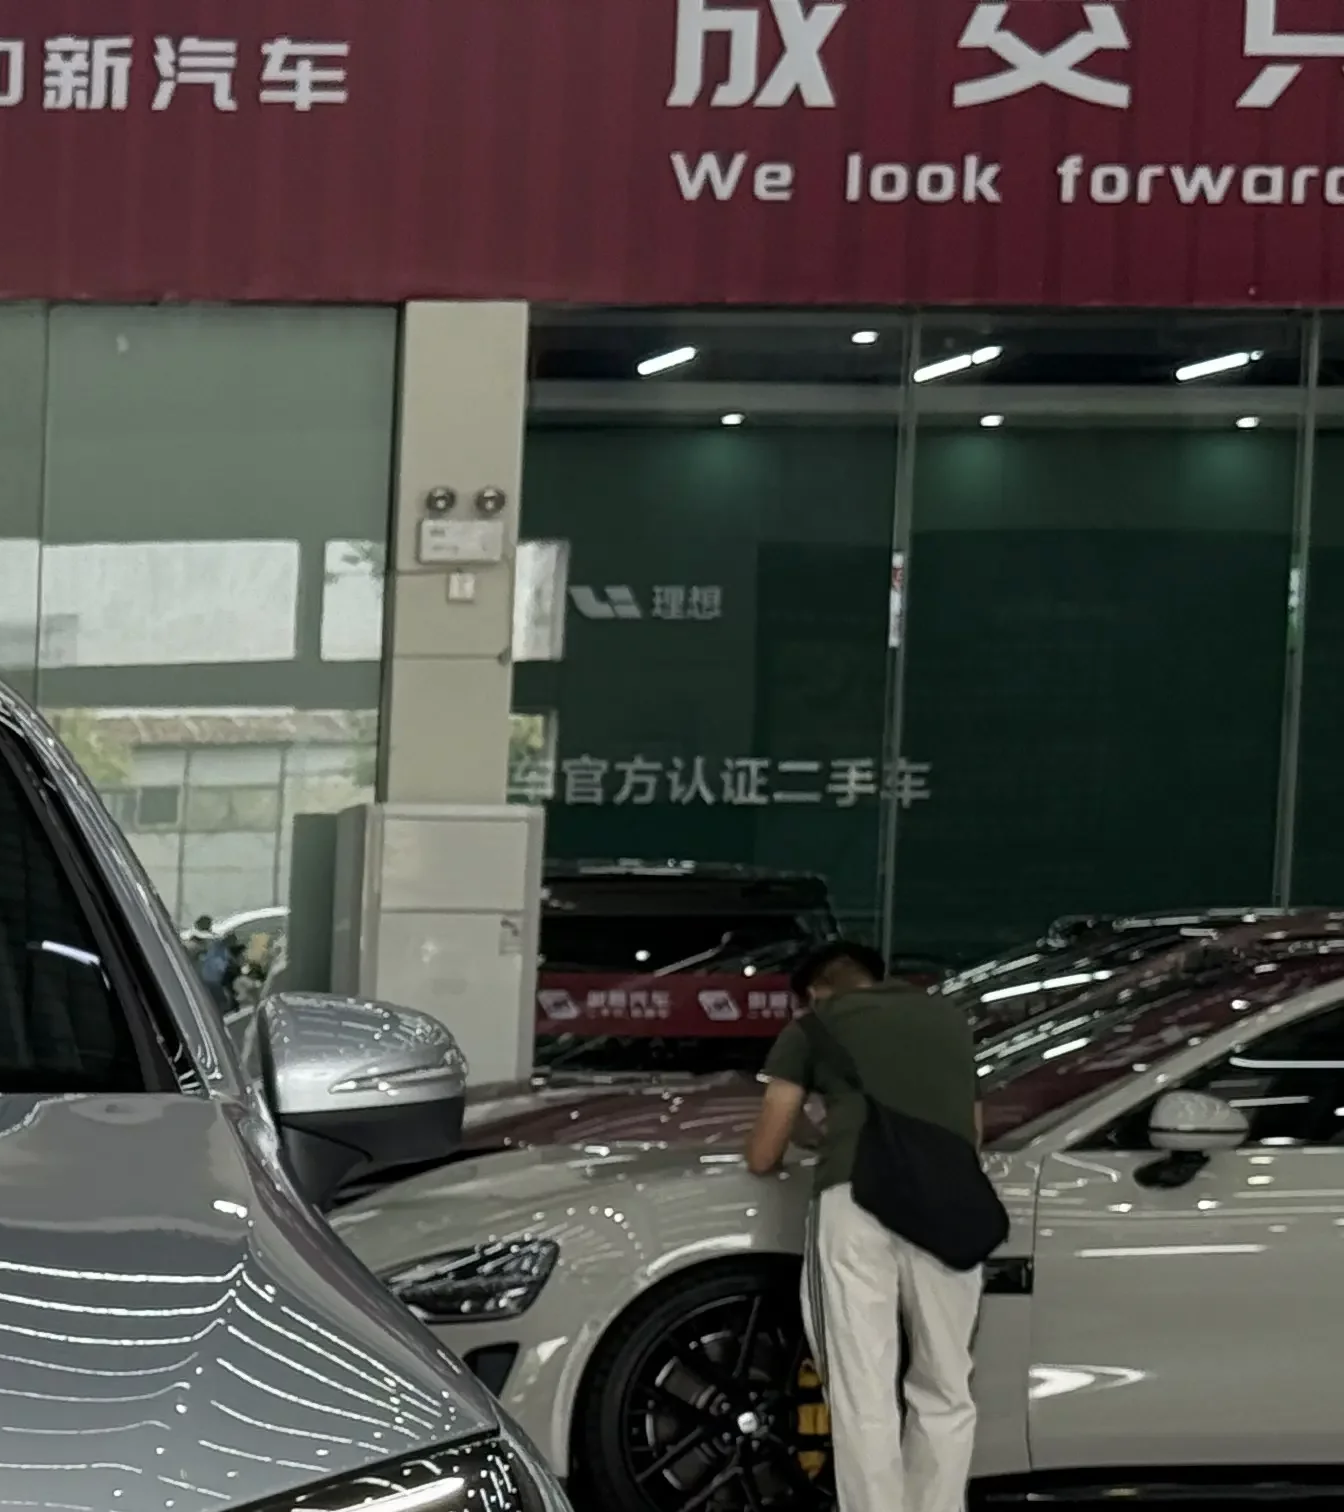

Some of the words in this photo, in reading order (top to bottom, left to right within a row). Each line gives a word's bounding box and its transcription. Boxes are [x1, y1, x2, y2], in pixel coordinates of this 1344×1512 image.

[670, 151, 794, 202] We
[846, 153, 1002, 203] look
[650, 584, 724, 621] 理想
